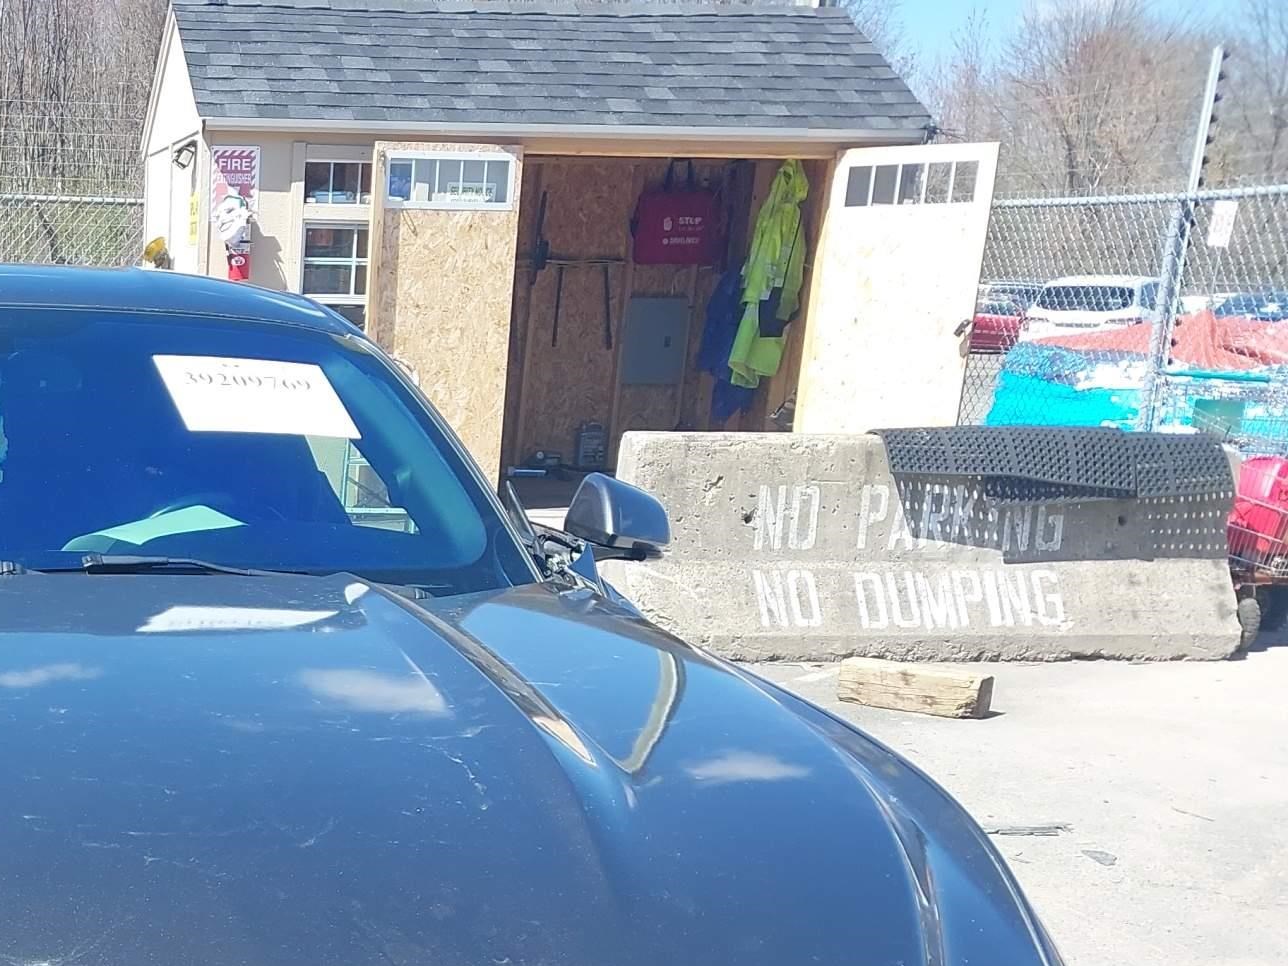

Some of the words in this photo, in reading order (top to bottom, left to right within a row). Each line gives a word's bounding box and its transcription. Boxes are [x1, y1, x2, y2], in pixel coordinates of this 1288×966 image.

[218, 158, 252, 171] FIRE
[754, 484, 821, 551] NO
[752, 569, 824, 628] NO
[853, 568, 1068, 631] DUMPING
